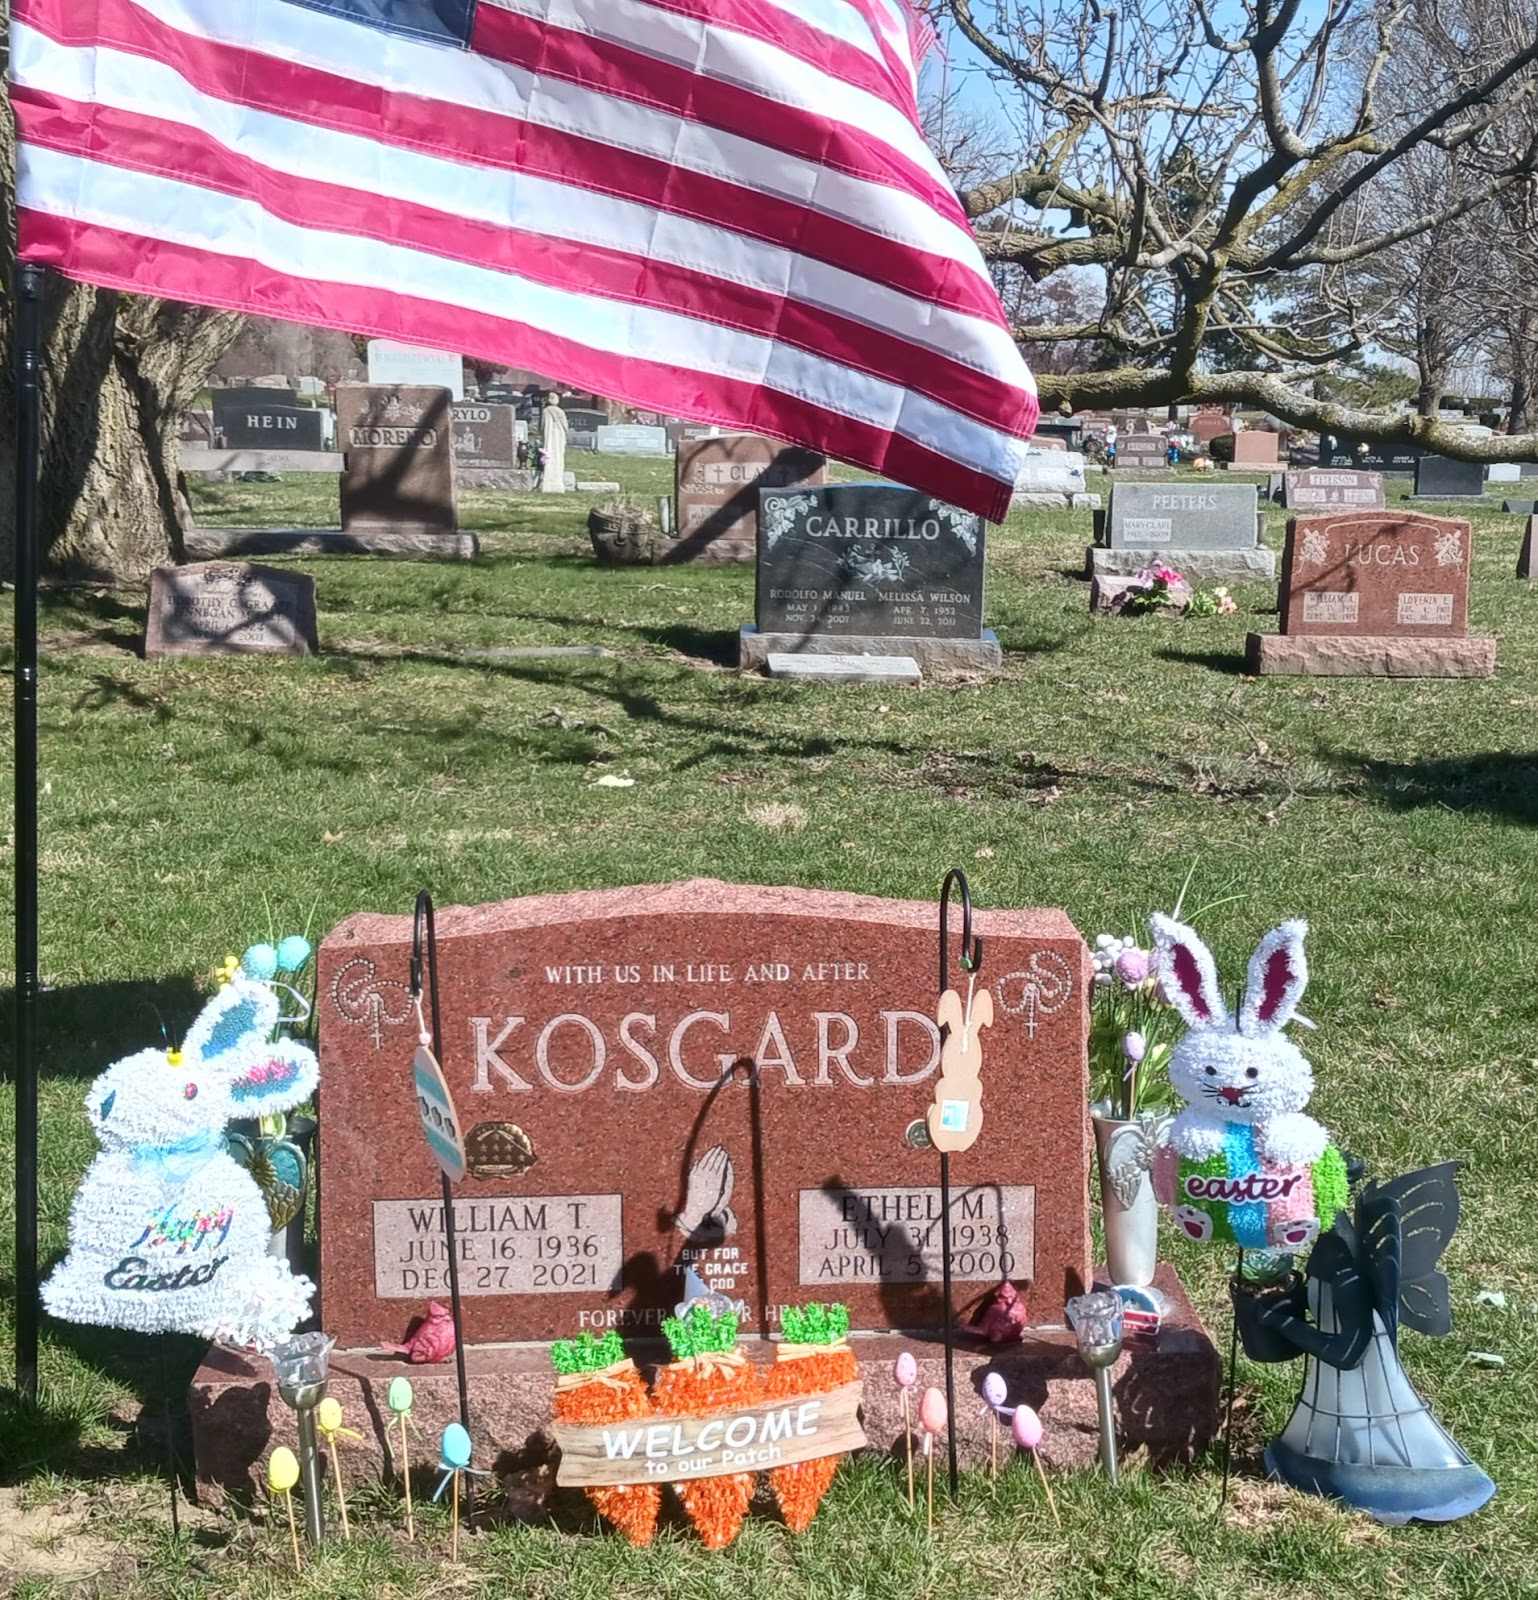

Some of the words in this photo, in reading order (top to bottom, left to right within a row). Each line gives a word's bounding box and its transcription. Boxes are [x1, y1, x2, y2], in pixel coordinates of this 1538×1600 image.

[246, 414, 297, 429] HEIN
[352, 429, 434, 446] MORENO
[1152, 494, 1217, 511] PEETERS
[806, 516, 940, 541] CARRILLO
[1344, 544, 1420, 566] LUCAS
[167, 596, 222, 607] DOROTHY
[769, 588, 818, 600] RODOLFO
[822, 589, 867, 601] MANUEL
[878, 591, 925, 603] MELISSA
[930, 592, 972, 604] WILSON
[786, 603, 808, 612] MAY
[934, 606, 956, 616] 1952
[827, 614, 850, 624] 2007
[893, 616, 915, 626] JUNE
[937, 617, 956, 627] 2011
[239, 633, 264, 641] 2003
[545, 965, 602, 984] WITH
[614, 965, 641, 983] US
[652, 964, 675, 983] IN
[686, 964, 733, 982] LIFE
[743, 963, 790, 982] AND
[802, 962, 870, 981] AFTER
[468, 1008, 942, 1092] KOSGARD
[1186, 1174, 1303, 1203] easter
[407, 1203, 547, 1233] WILLIAM
[566, 1203, 591, 1230] T.
[842, 1194, 944, 1223] ETHEL
[961, 1193, 993, 1221] M.
[824, 1226, 891, 1251] JULY
[952, 1223, 1009, 1247] 1938
[400, 1237, 477, 1263] JUNE
[537, 1234, 599, 1260] 1936
[682, 1248, 708, 1260] BUT
[713, 1247, 740, 1260] FOR
[104, 1255, 229, 1291] Easter
[705, 1262, 749, 1275] GRACE
[818, 1254, 892, 1278] APRIL
[946, 1251, 1015, 1275] 2000
[532, 1263, 597, 1287] 2021
[710, 1277, 736, 1290] GOD
[578, 1308, 668, 1328] FOREVER
[601, 1401, 822, 1460] WELCOME
[645, 1459, 668, 1475] to
[678, 1456, 712, 1473] our
[722, 1442, 782, 1468] Patch
